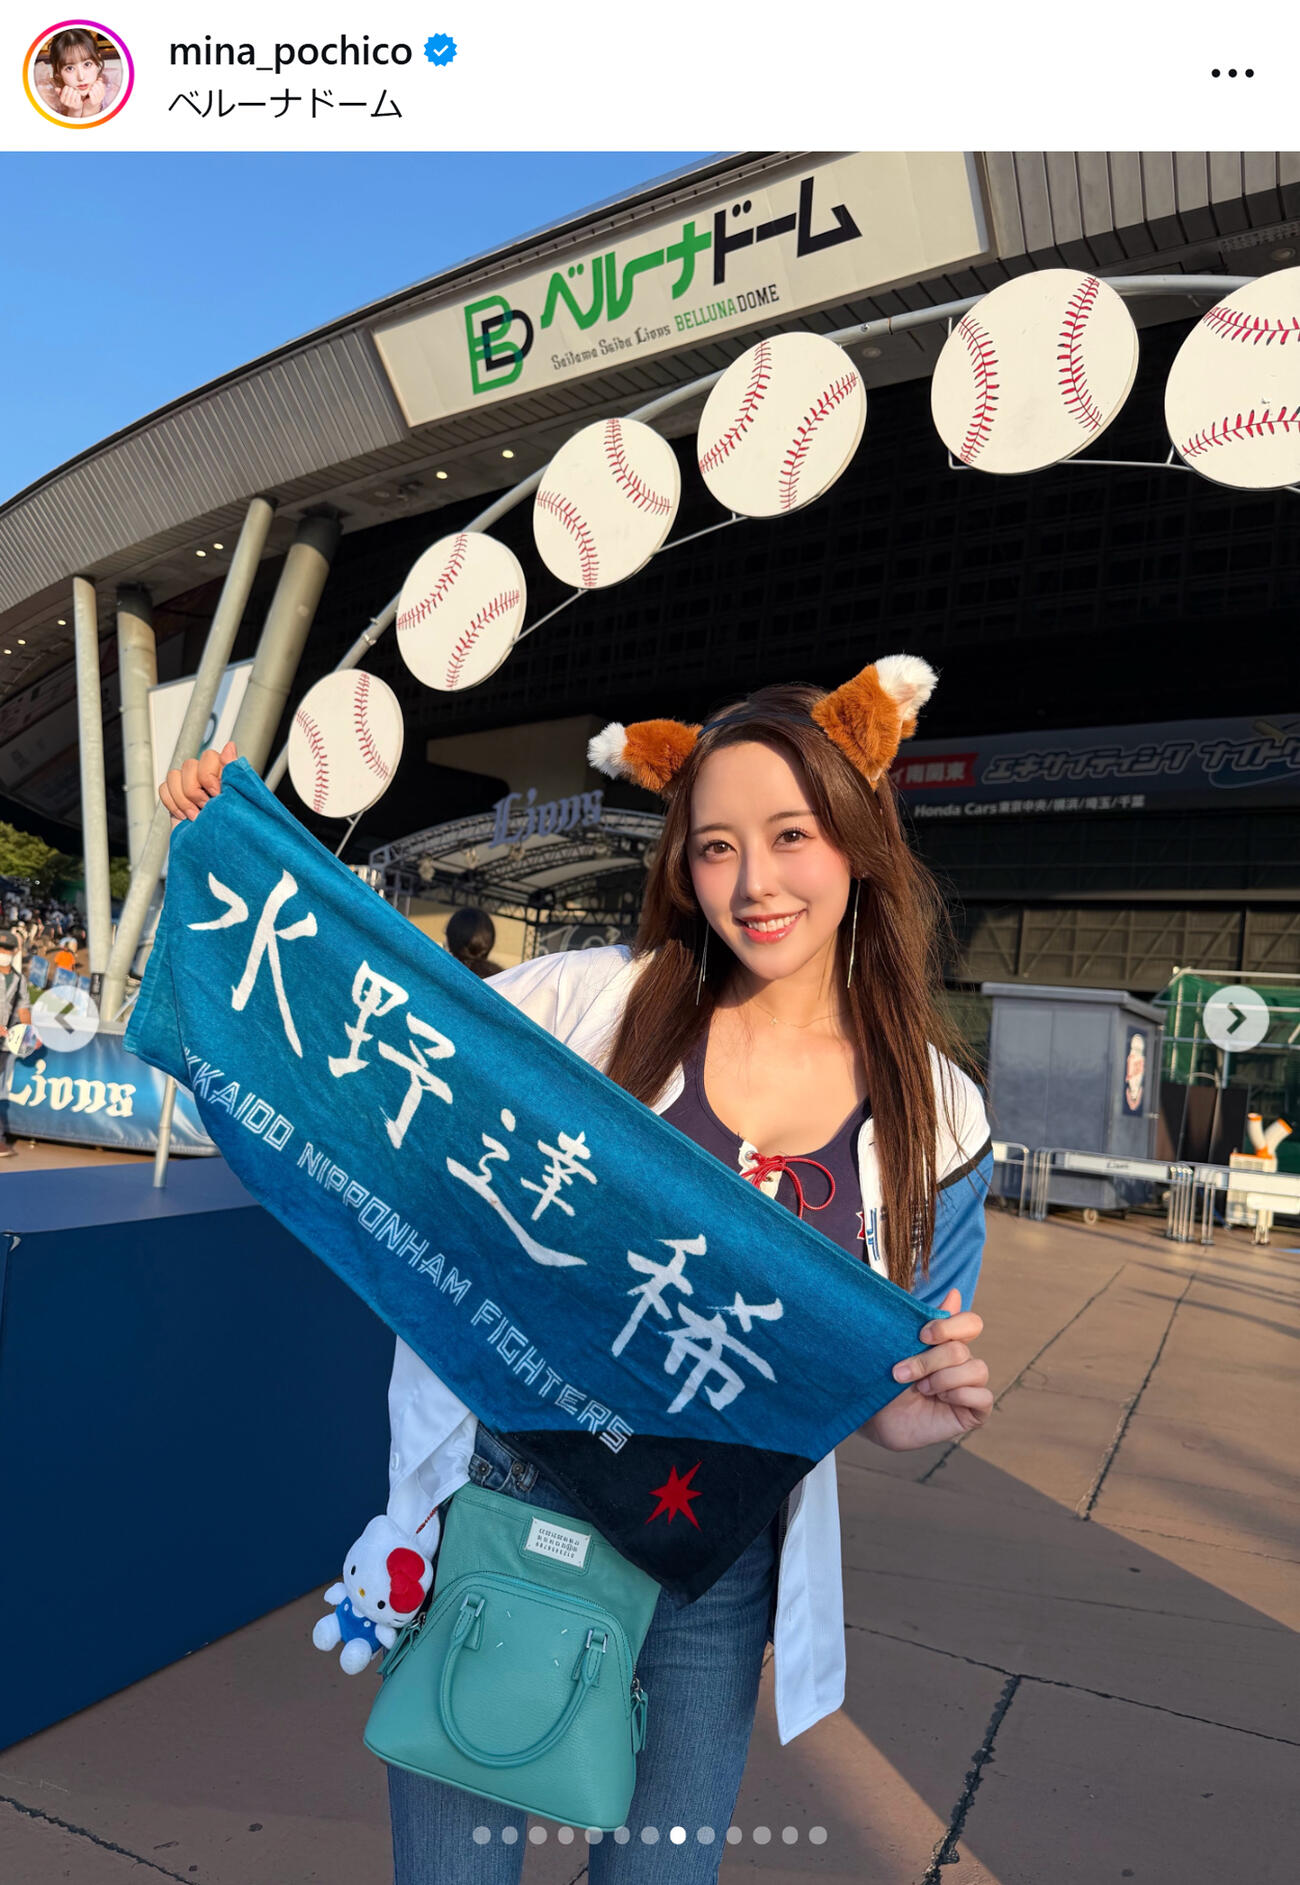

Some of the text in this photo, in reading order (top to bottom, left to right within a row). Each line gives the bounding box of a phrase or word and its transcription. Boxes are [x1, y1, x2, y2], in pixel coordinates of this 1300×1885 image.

[540, 176, 863, 331] ベルーナドーム
[634, 325, 671, 346] Lions
[488, 787, 604, 848] Lions
[914, 804, 961, 818] Honda
[964, 802, 997, 816] Cars
[7, 1058, 137, 1118] Lions
[296, 1139, 473, 1306] NIPPONHAM
[471, 1298, 635, 1455] FIGHTERS
